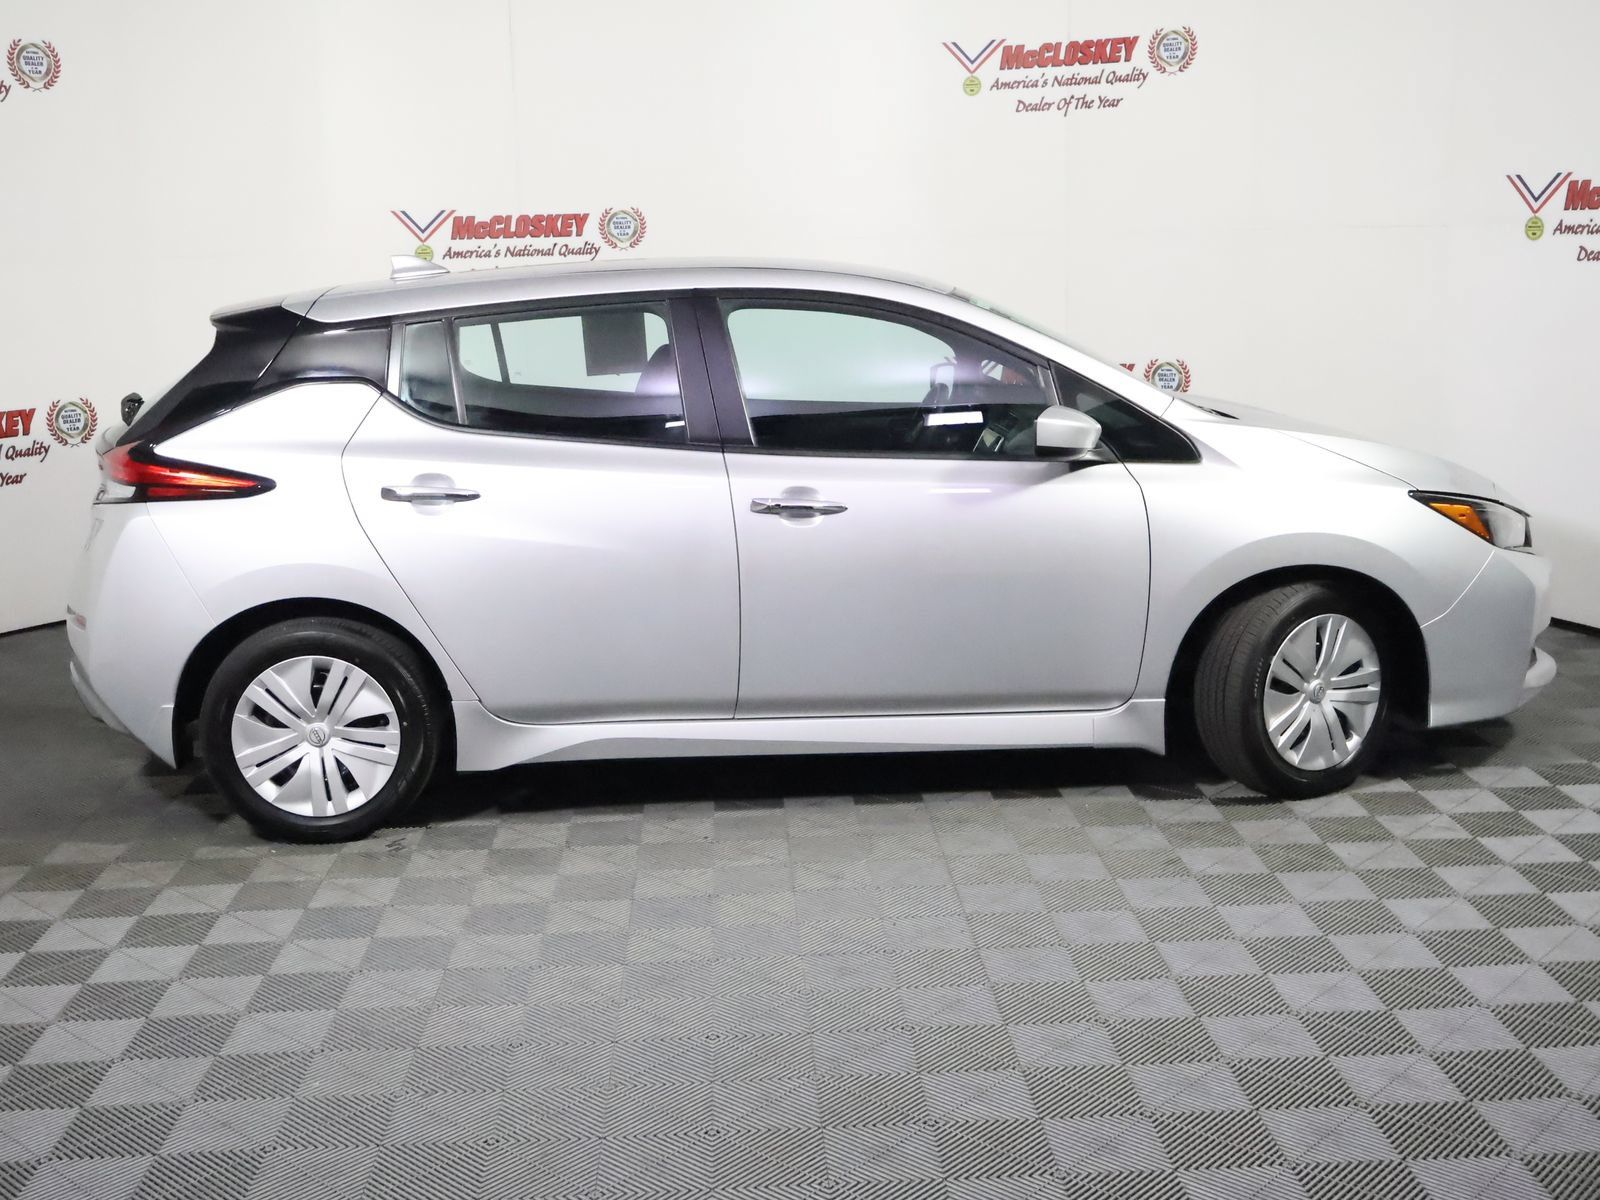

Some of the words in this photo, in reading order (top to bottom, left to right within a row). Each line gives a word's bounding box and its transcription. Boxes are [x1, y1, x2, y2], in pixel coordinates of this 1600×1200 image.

[1000, 36, 1139, 70] McCLOSKEY
[990, 73, 1048, 91] America's
[1052, 69, 1104, 88] National
[1106, 67, 1149, 89] Quality
[1015, 97, 1055, 113] Dealer
[1056, 95, 1075, 117] Of
[1073, 94, 1095, 110] The
[1097, 96, 1124, 110] Year
[451, 213, 589, 240] McCLOSKEY
[442, 243, 501, 260] America's
[504, 243, 557, 259] National
[558, 241, 601, 261] Quality
[5, 440, 51, 463] Quality
